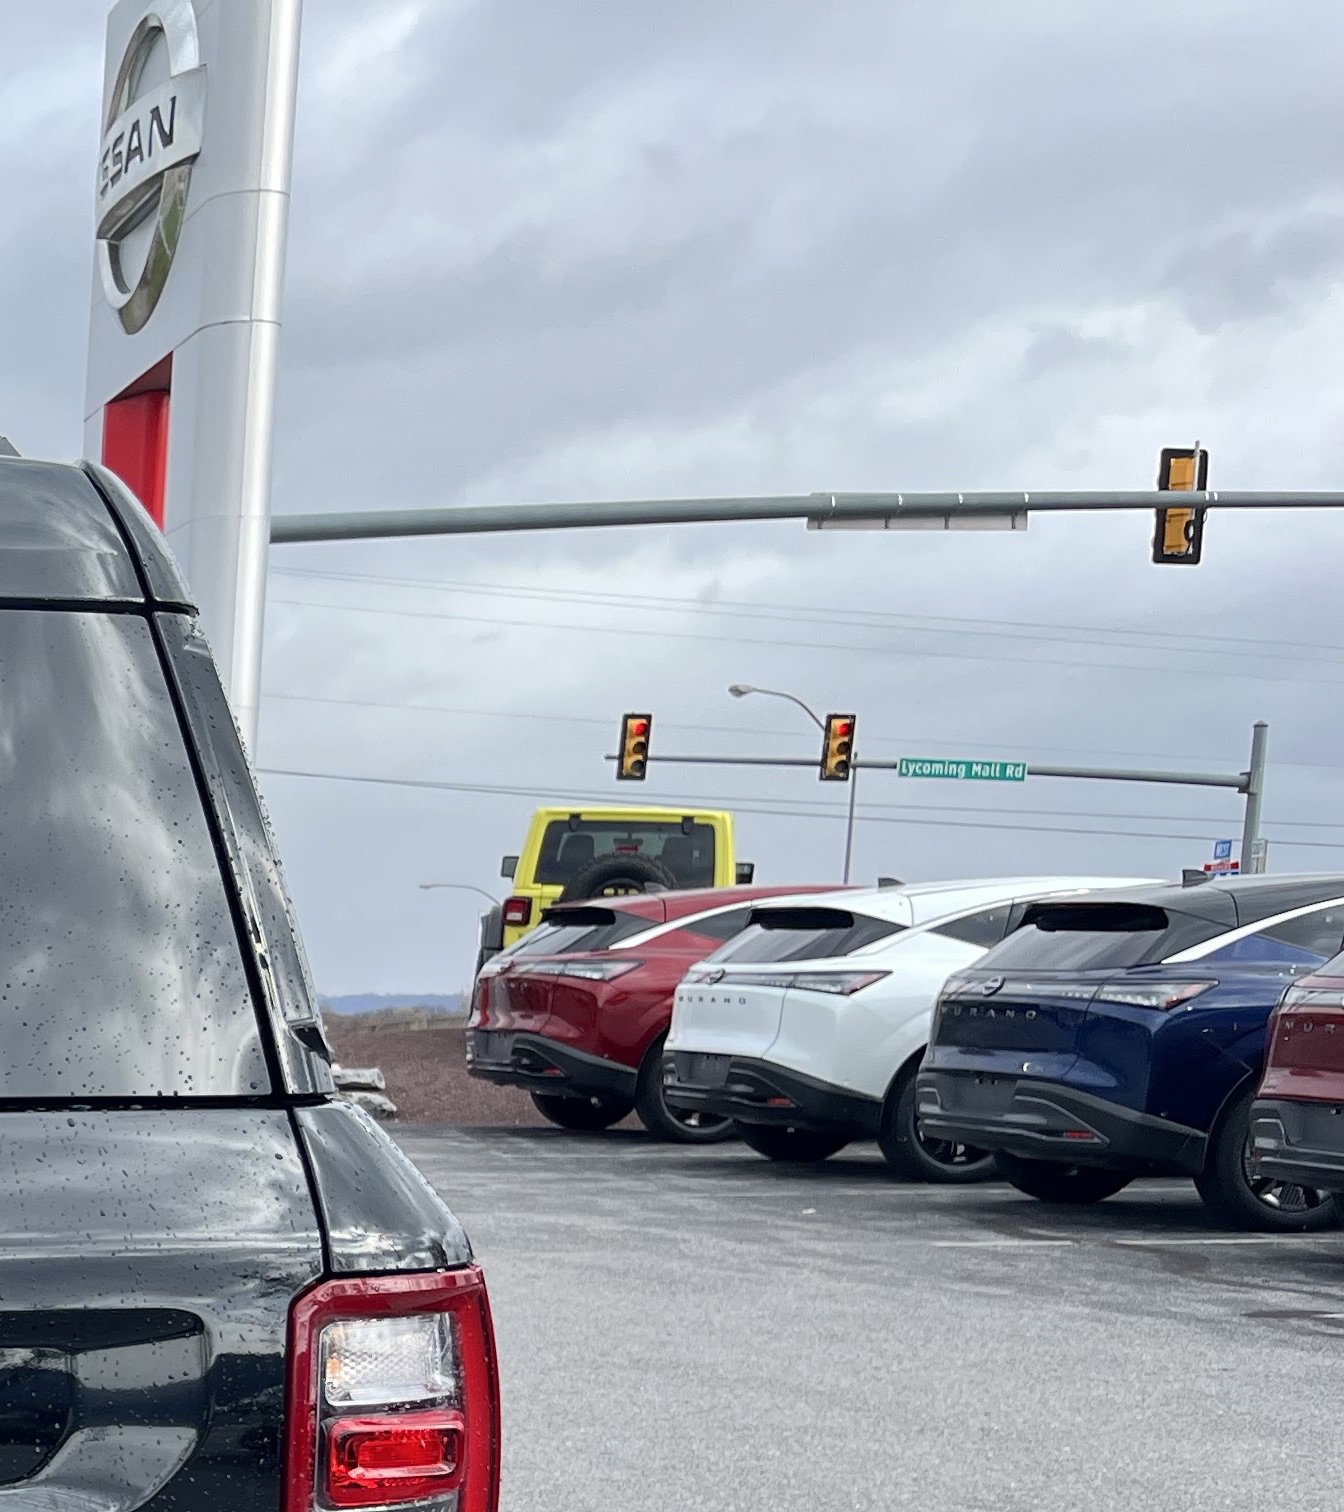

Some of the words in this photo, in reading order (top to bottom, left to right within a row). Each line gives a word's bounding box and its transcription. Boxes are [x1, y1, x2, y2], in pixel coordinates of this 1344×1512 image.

[100, 95, 177, 197] SSAN
[902, 760, 966, 780] Lycoming
[971, 763, 1000, 778] Mall
[1006, 764, 1023, 779] Rd
[1285, 1020, 1337, 1034] MUR
